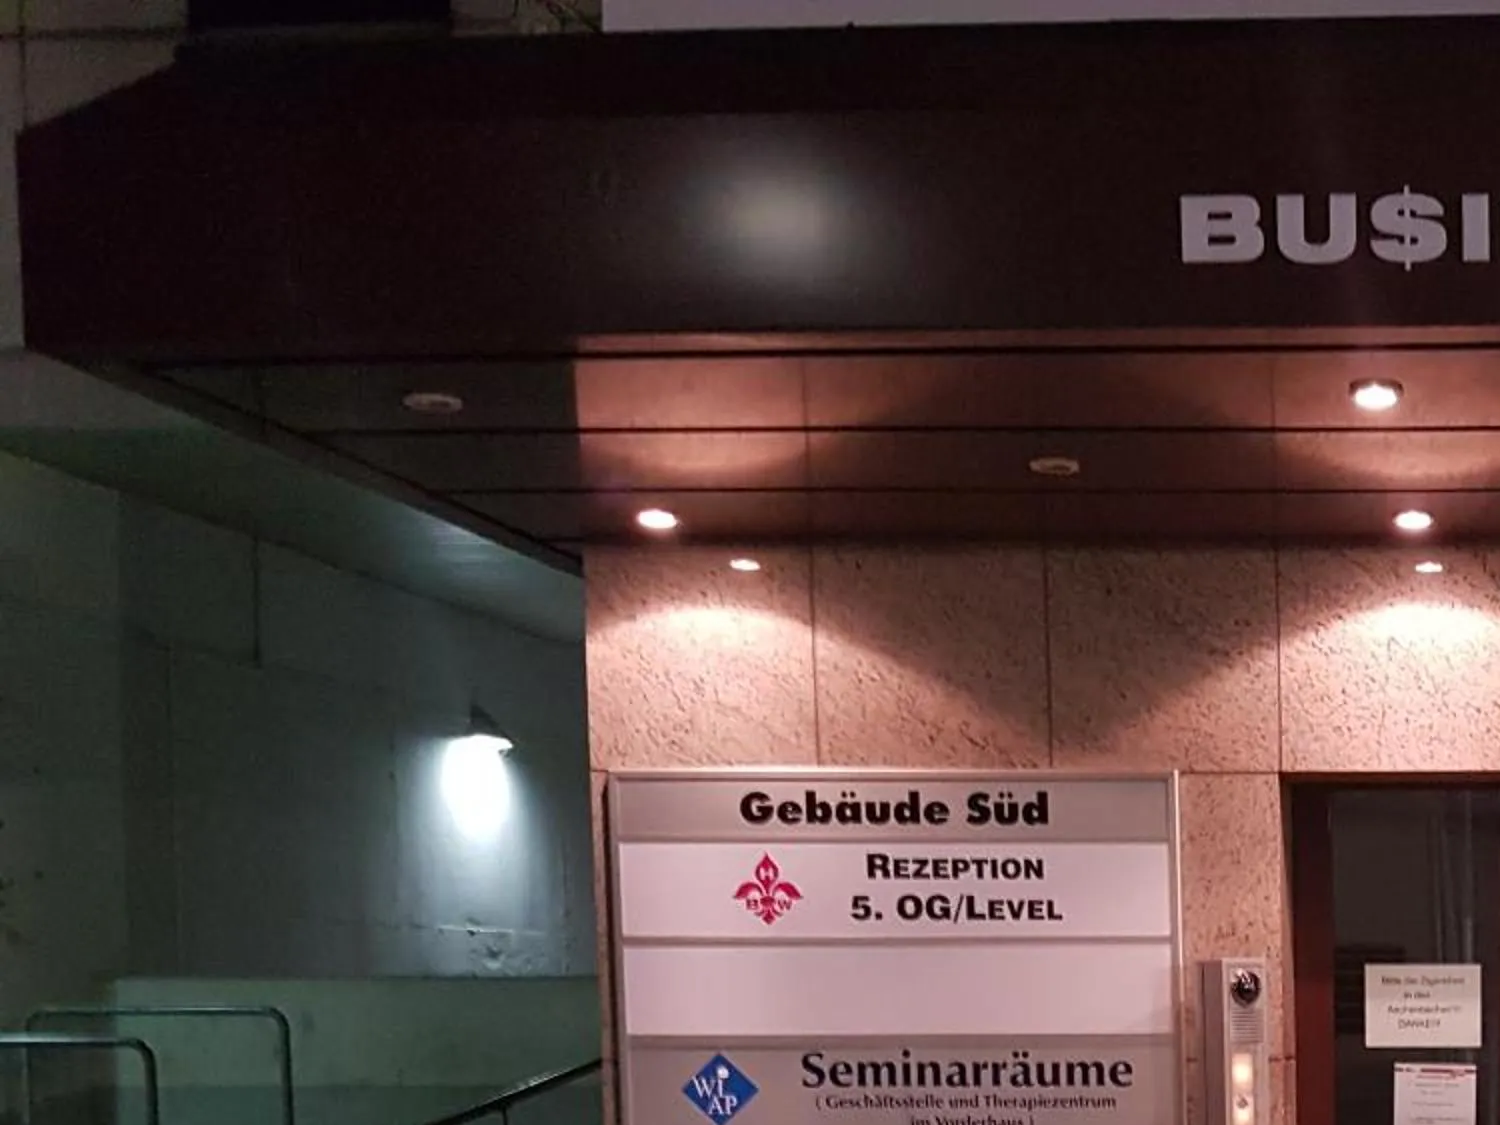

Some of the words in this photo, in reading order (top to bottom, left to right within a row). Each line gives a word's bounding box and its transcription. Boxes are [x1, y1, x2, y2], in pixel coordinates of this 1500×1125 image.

[740, 790, 950, 825] Gebäude
[966, 790, 1050, 825] Süd
[851, 895, 883, 921] 5.
[801, 1050, 1133, 1088] Seminarräume
[949, 1095, 979, 1109] und
[984, 1095, 1116, 1112] Therapiezentrum
